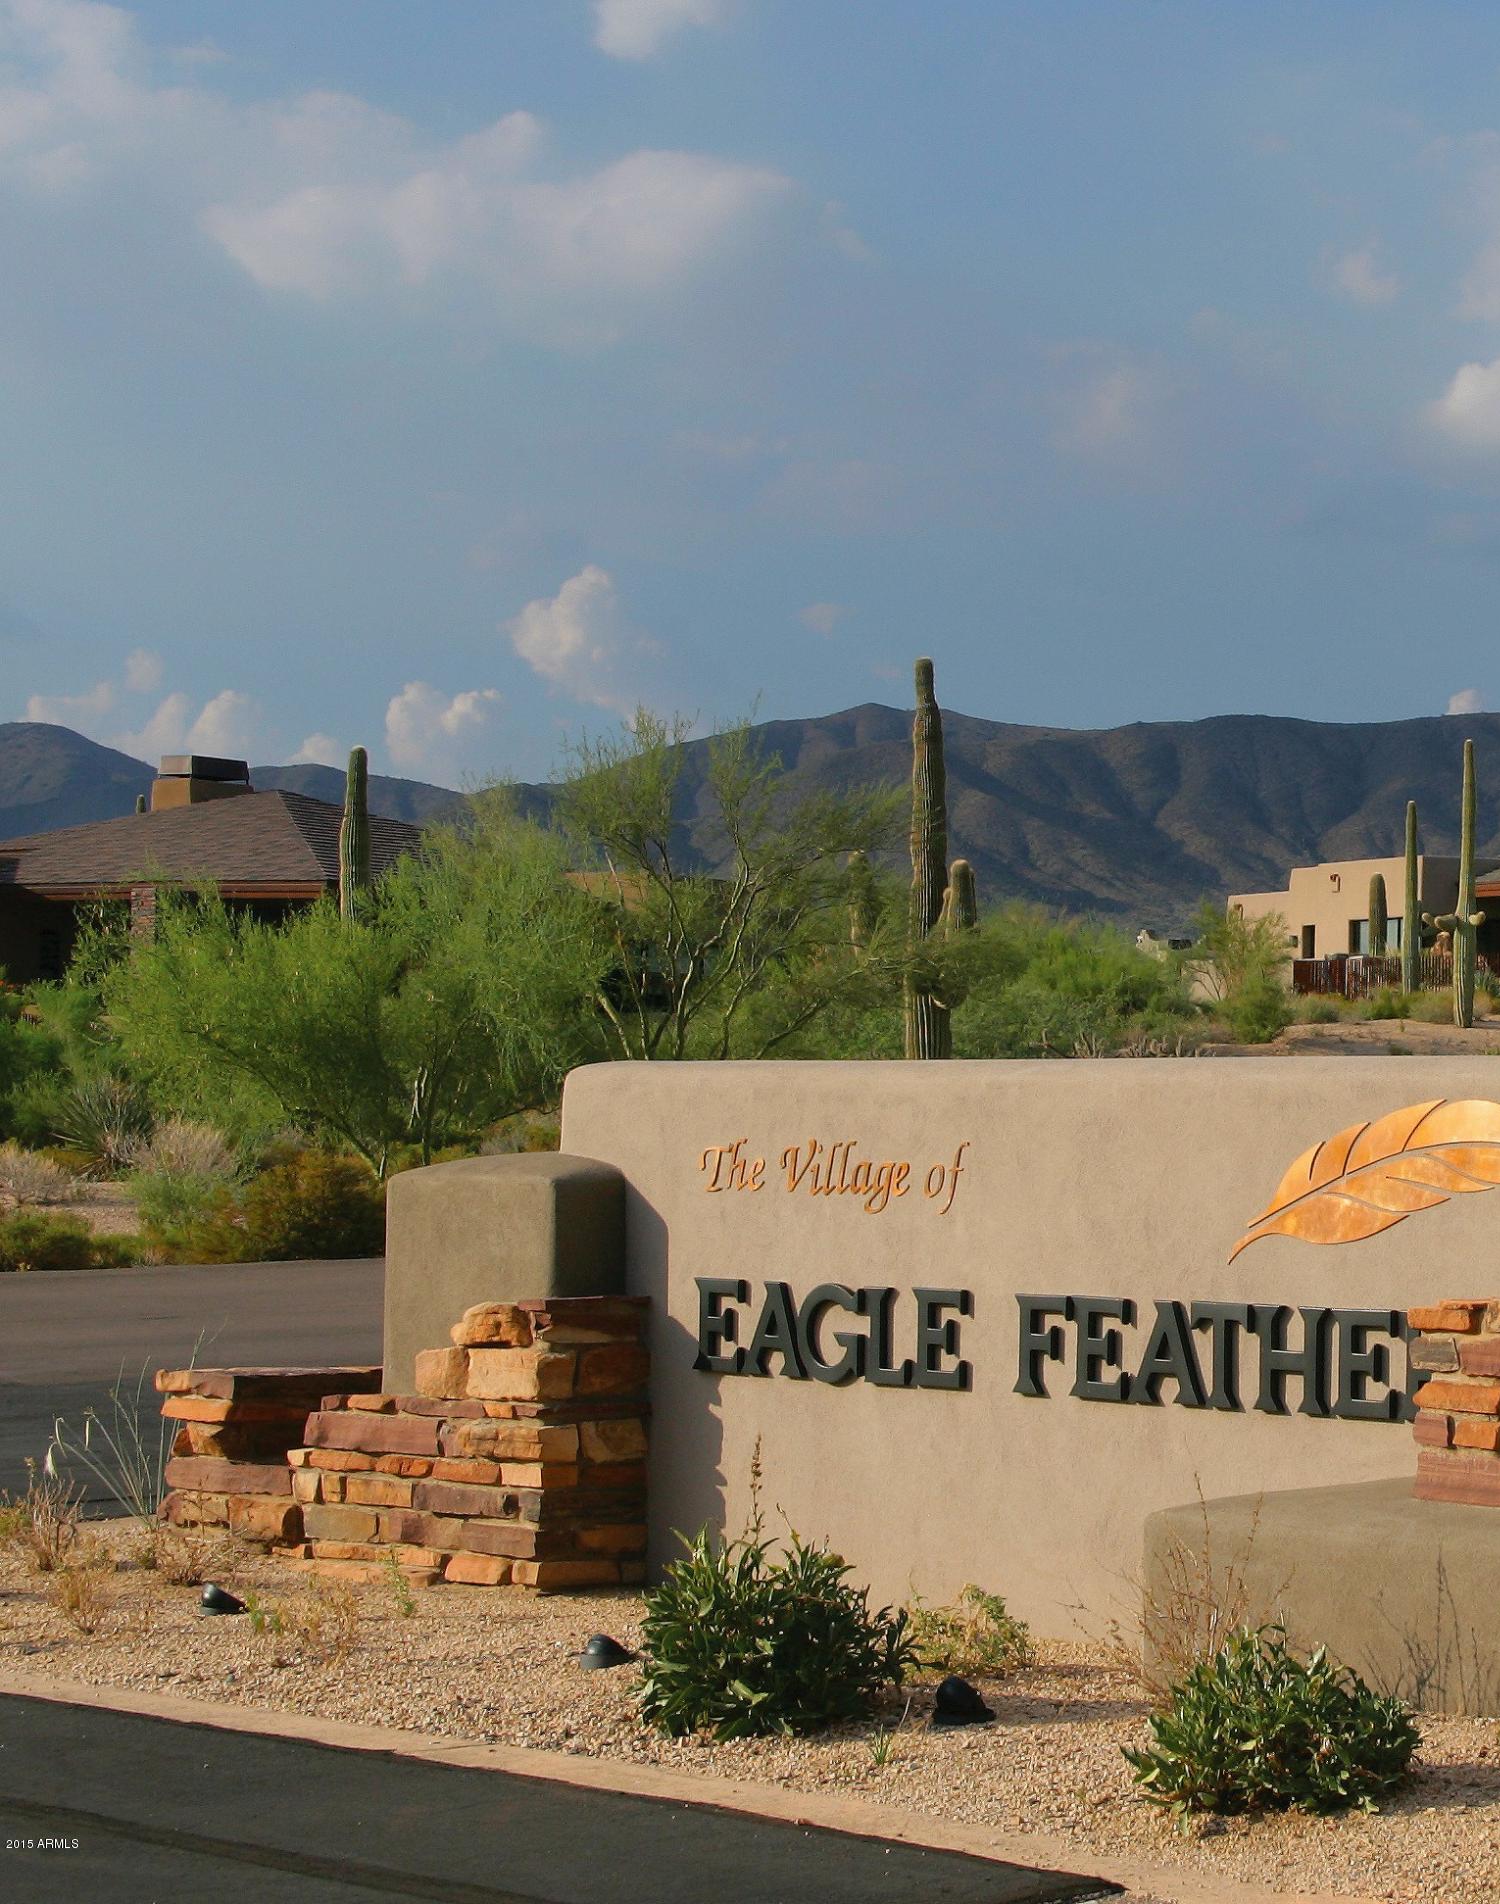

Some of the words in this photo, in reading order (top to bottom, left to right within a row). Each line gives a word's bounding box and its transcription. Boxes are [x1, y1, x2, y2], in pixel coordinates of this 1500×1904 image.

[700, 1138, 766, 1192] The
[780, 1138, 910, 1214] Village
[923, 1141, 970, 1214] of
[693, 1277, 974, 1392] EAGLE
[1012, 1293, 1430, 1424] FEATHE
